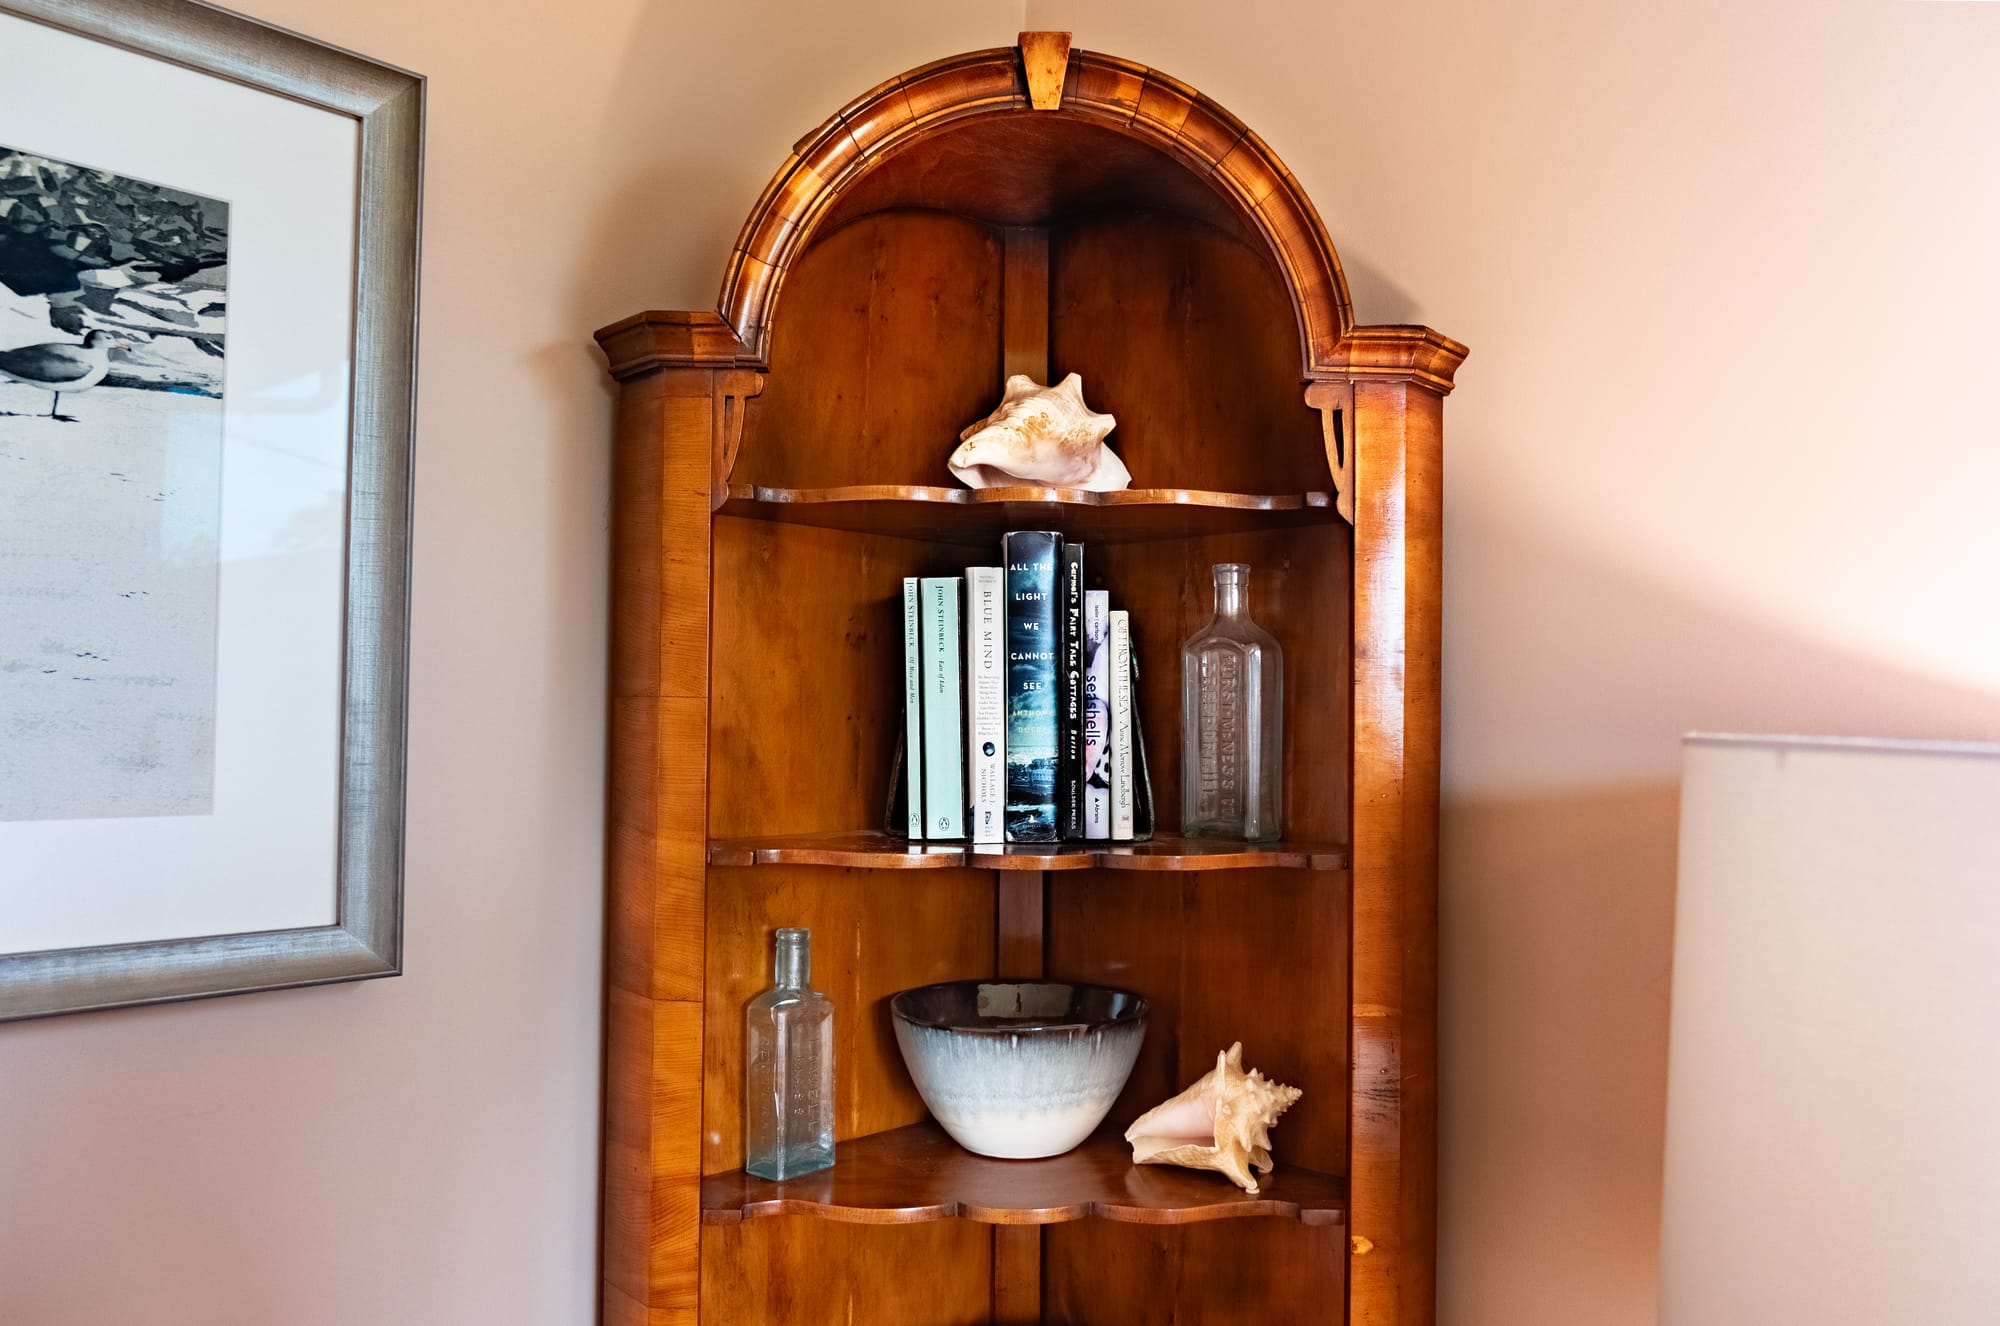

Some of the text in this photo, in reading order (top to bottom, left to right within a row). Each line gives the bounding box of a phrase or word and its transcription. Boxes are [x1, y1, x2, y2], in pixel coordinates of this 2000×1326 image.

[1010, 563, 1053, 571] ALL THE
[906, 582, 914, 603] JOHN
[935, 585, 944, 607] JOHN
[1015, 592, 1048, 601] LIGHT
[983, 591, 992, 624] BLUE
[937, 609, 945, 653] STEINBECK
[1023, 622, 1040, 630] WE
[983, 631, 993, 669] MIND
[1010, 652, 1054, 660] CANNOT
[1118, 619, 1129, 715] GIFT FROM THE SEA
[1023, 682, 1042, 690] SEE
[1012, 709, 1053, 717] ANTHONY
[1086, 675, 1101, 746] seashells
